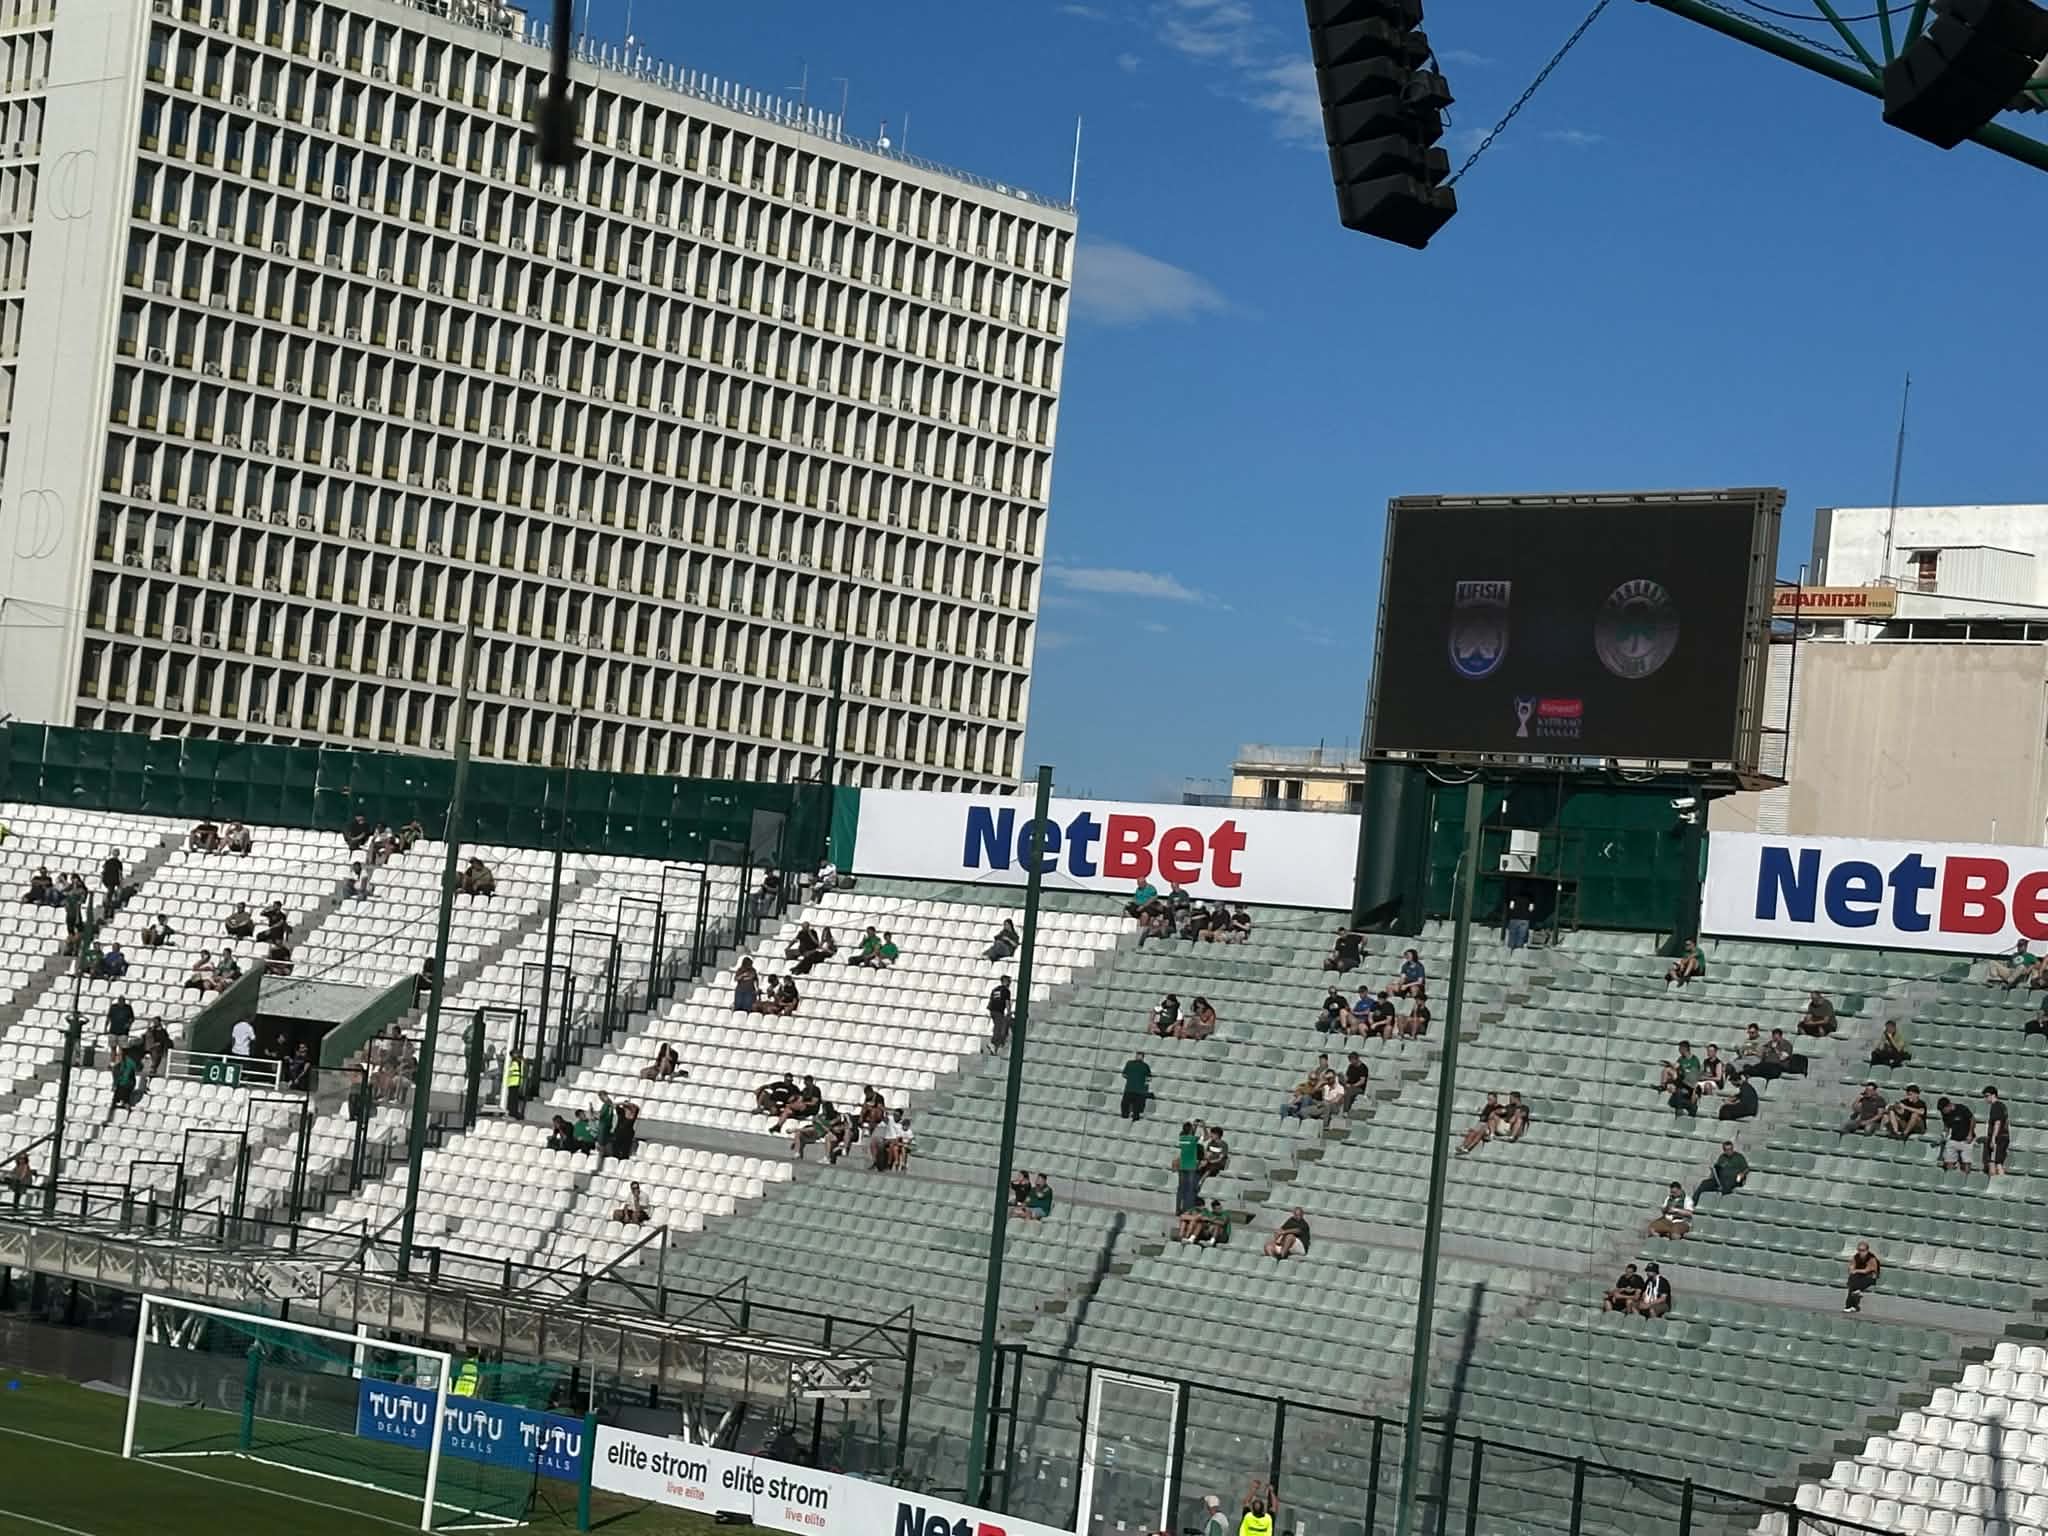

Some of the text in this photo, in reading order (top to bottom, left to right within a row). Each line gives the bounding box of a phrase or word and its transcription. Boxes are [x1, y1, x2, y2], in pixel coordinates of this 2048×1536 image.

[962, 806, 1247, 888] NetBet
[369, 1392, 427, 1425] TUTU
[444, 1407, 503, 1440] TUTU
[377, 1422, 417, 1438] DEALS
[451, 1436, 492, 1454] DEALS
[520, 1421, 581, 1457] TUTU
[528, 1452, 571, 1471] DEALS
[608, 1441, 707, 1483] elite strom
[722, 1466, 828, 1509] elite strom
[785, 1507, 803, 1521] live
